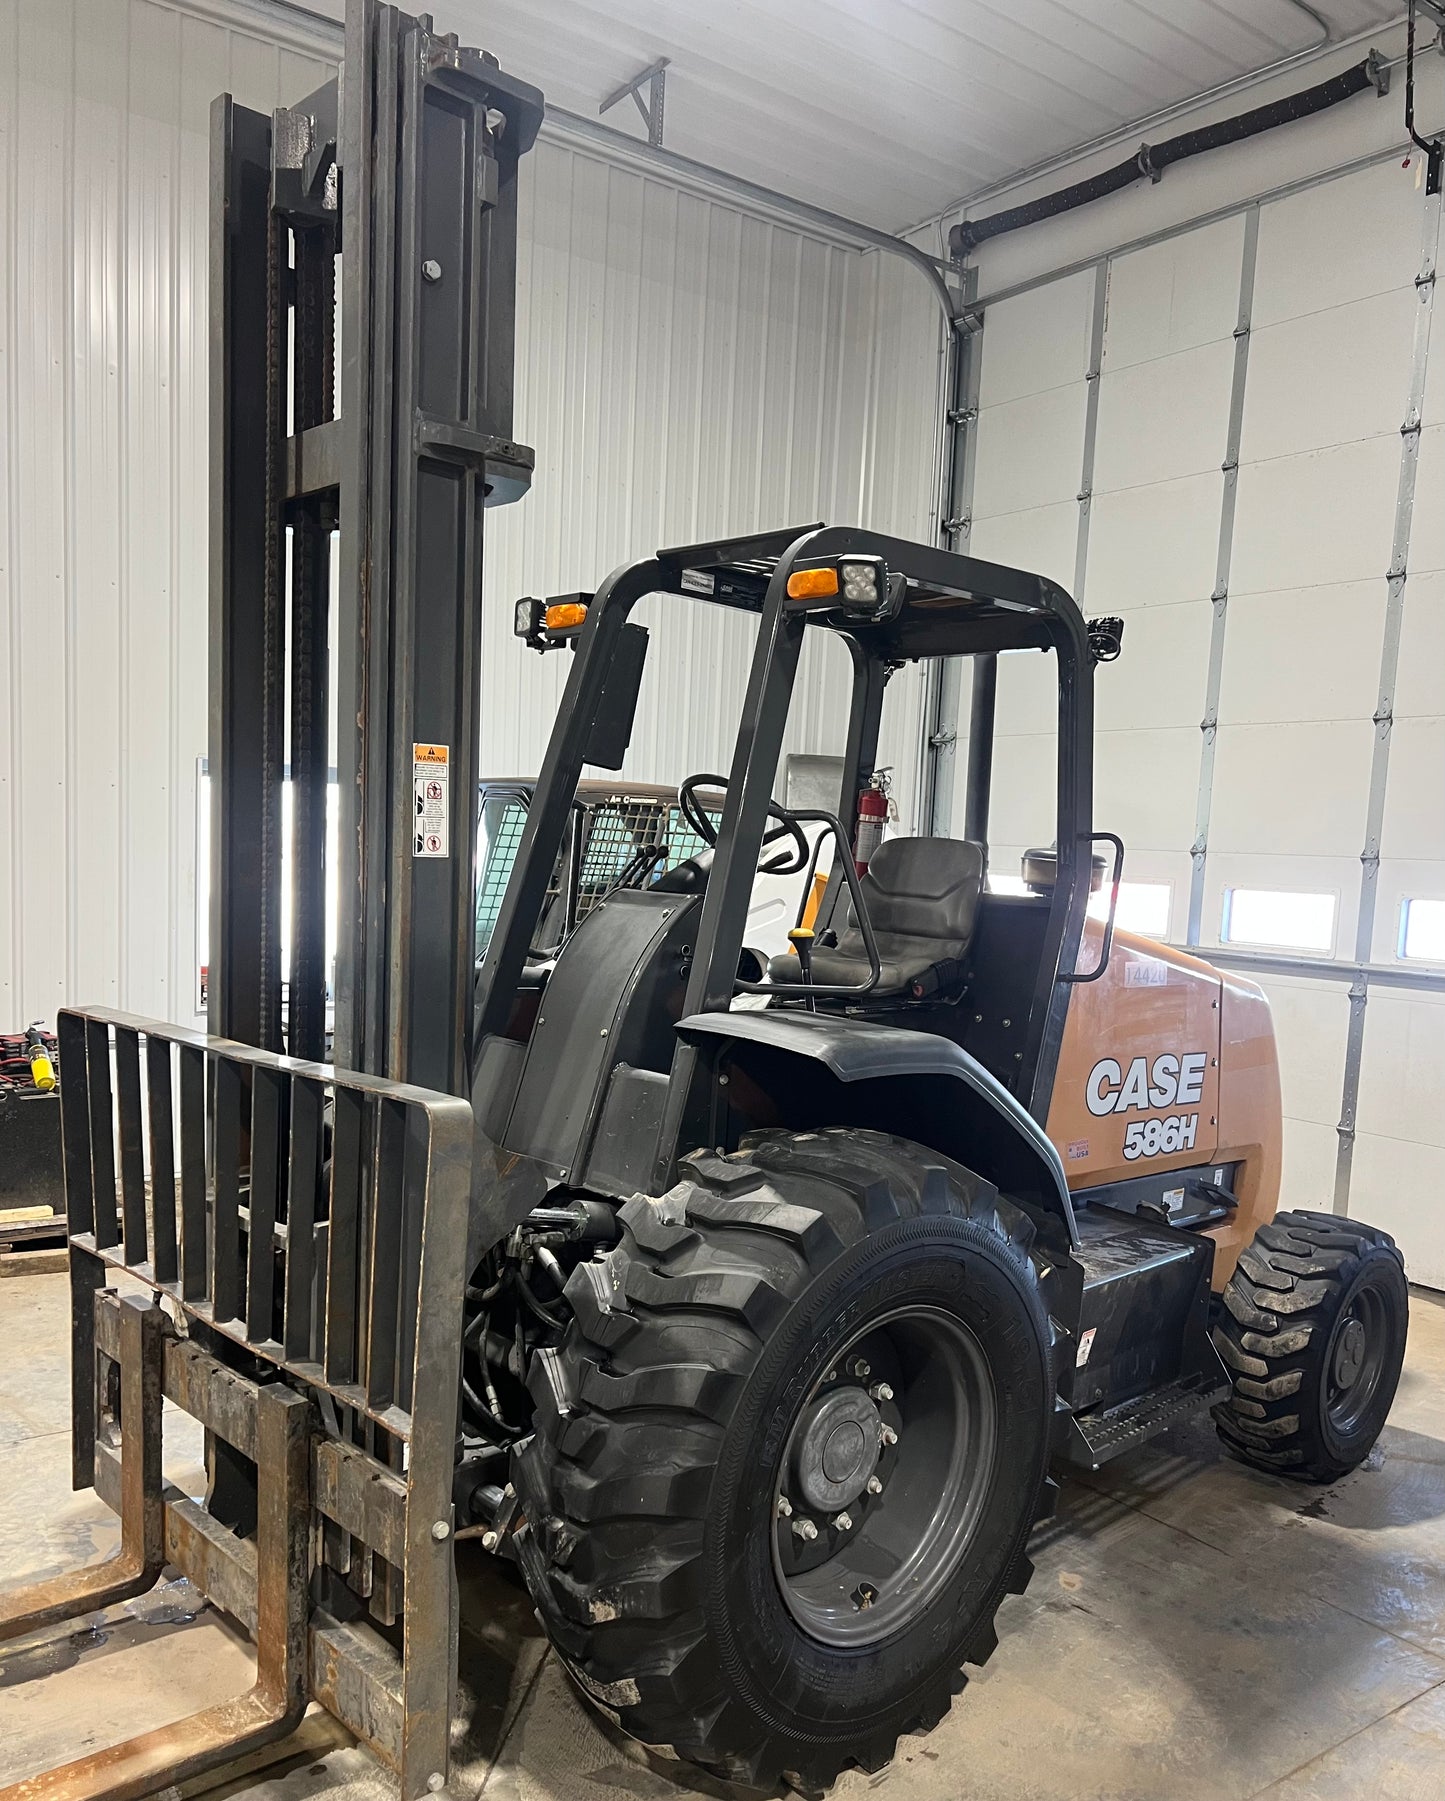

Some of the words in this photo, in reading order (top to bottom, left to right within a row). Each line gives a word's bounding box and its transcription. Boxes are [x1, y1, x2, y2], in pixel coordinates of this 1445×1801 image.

[416, 755, 446, 763] WARNING
[1085, 1052, 1208, 1117] CASE
[1123, 1114, 1199, 1161] 586H
[1076, 1150, 1089, 1158] USA
